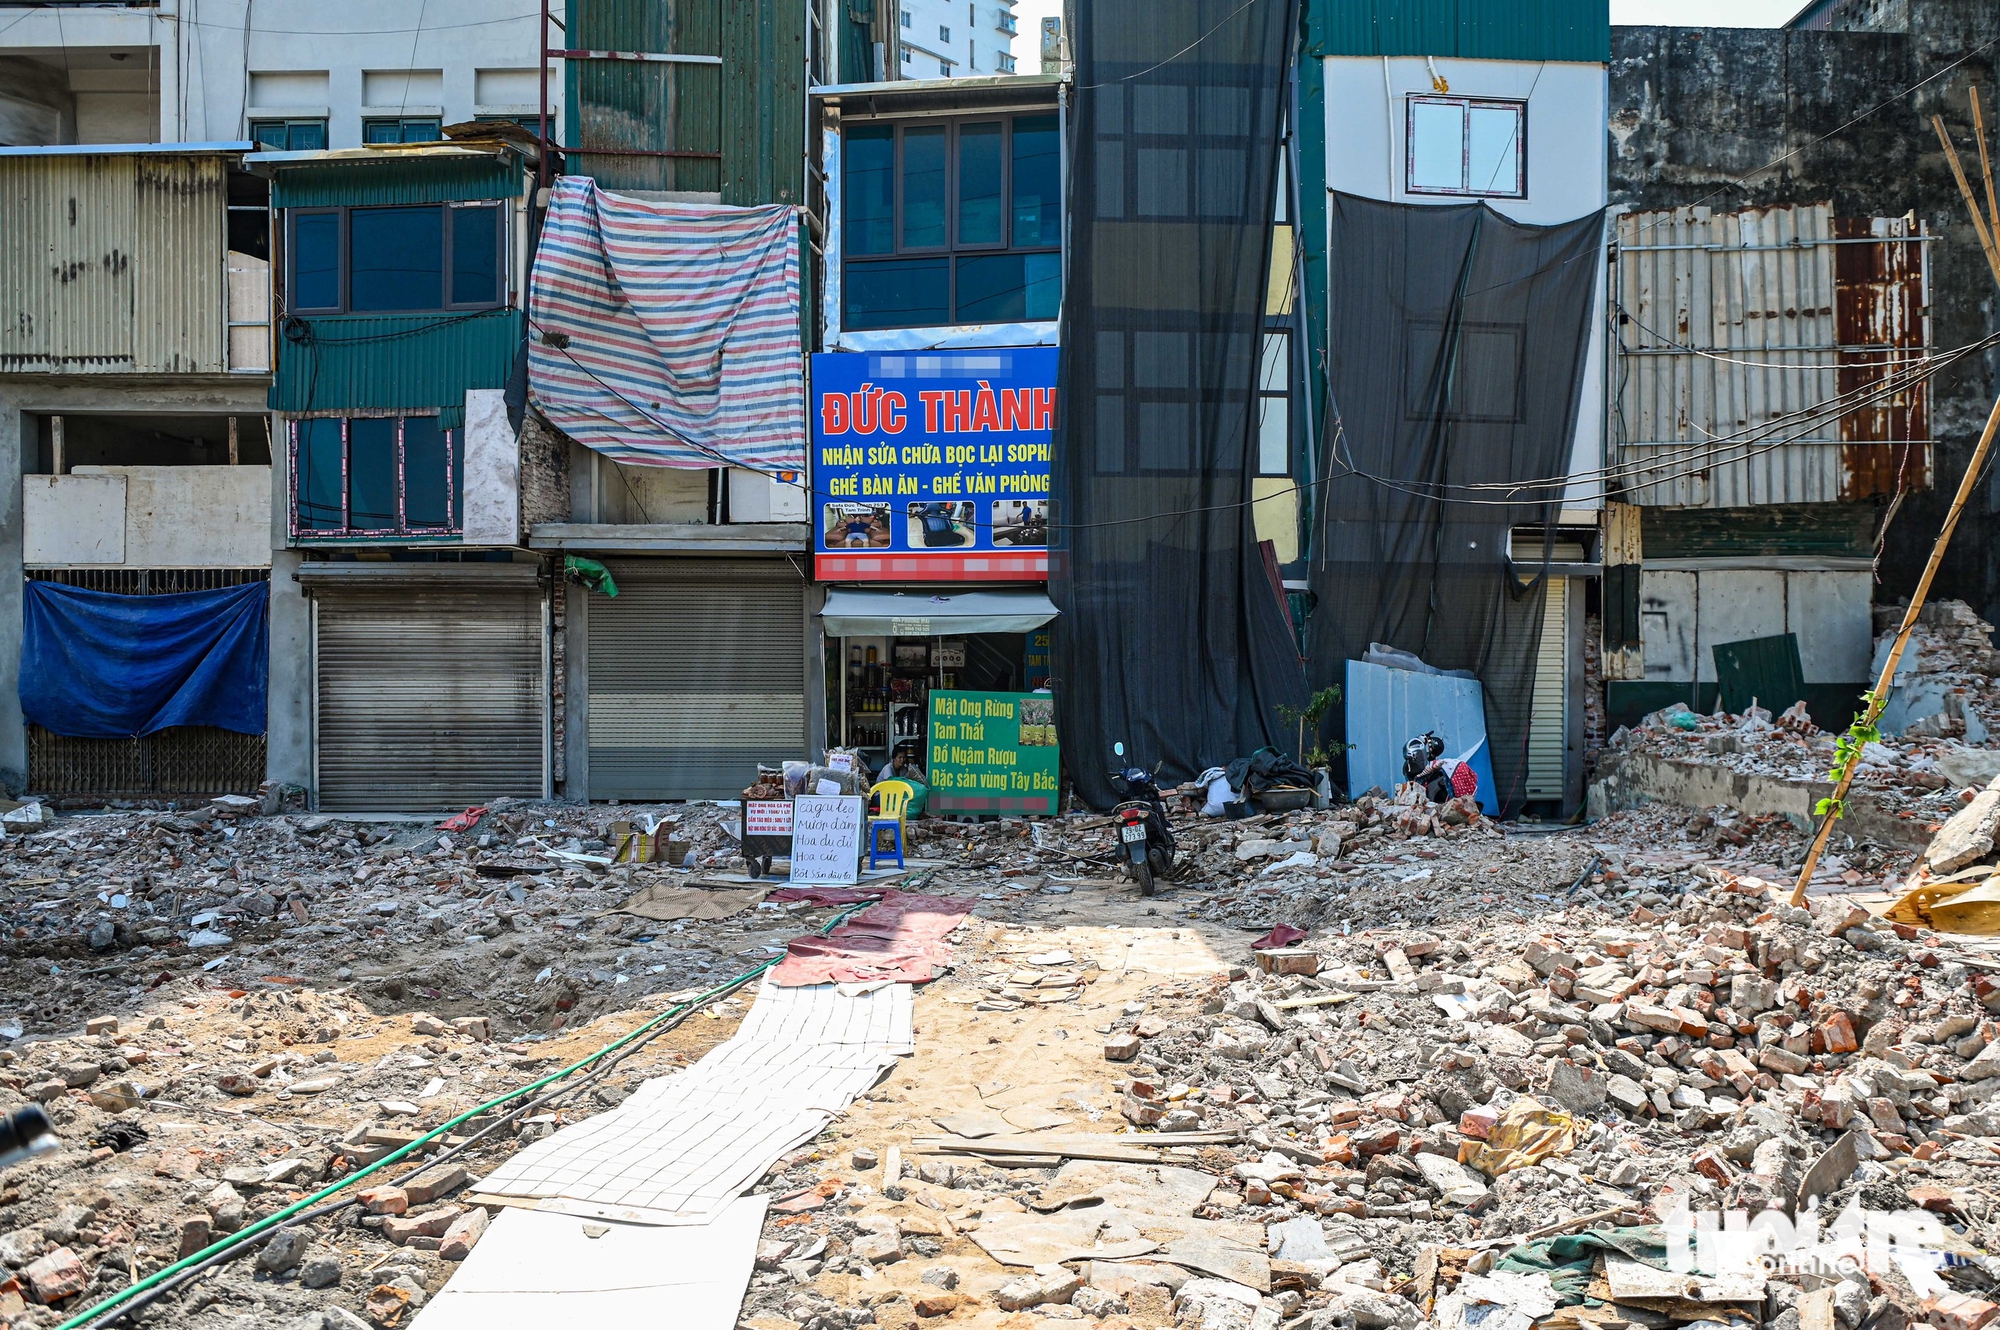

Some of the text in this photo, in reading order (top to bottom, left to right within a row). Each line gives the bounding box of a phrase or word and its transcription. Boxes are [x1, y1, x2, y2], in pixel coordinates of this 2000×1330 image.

[821, 380, 1060, 435] ĐỨC THÀNH
[822, 441, 1057, 469] NHẬN SỬA CHỮA BỌC LẠI SOPHA
[830, 472, 859, 496] GHẾ
[862, 474, 893, 496] BÀN
[897, 474, 918, 495] ĂN
[932, 471, 963, 495] GHẾ
[965, 472, 996, 494] VĂN
[1000, 471, 1050, 493] PHÒNG
[935, 697, 1014, 719] Mật Ong Rừng
[934, 720, 985, 741] Tam Thất
[933, 743, 1017, 769] Đồ Ngâm Rượu
[932, 768, 1058, 791] Đặc sản vùng Tây Bắc.
